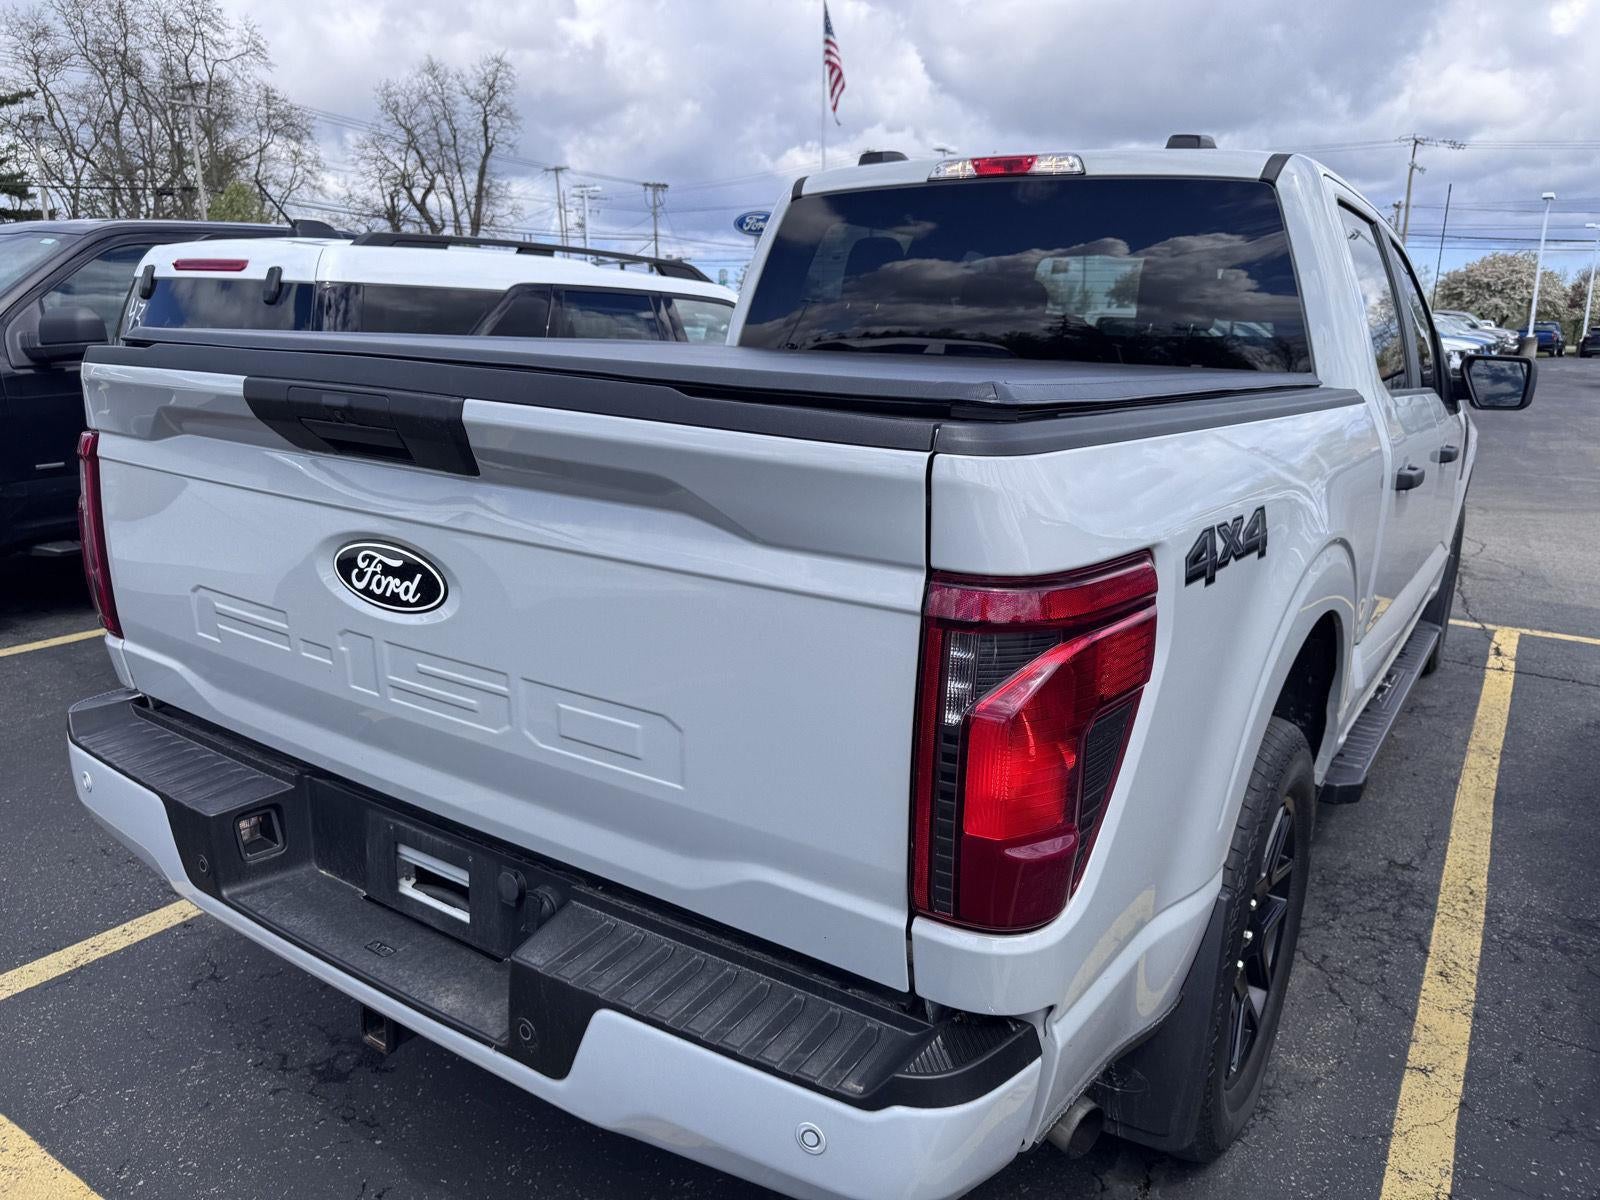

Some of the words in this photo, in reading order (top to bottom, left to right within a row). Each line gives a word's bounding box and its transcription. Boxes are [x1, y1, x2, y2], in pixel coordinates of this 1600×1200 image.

[742, 215, 768, 231] For
[351, 550, 422, 603] Ford
[190, 584, 685, 790] F-150
